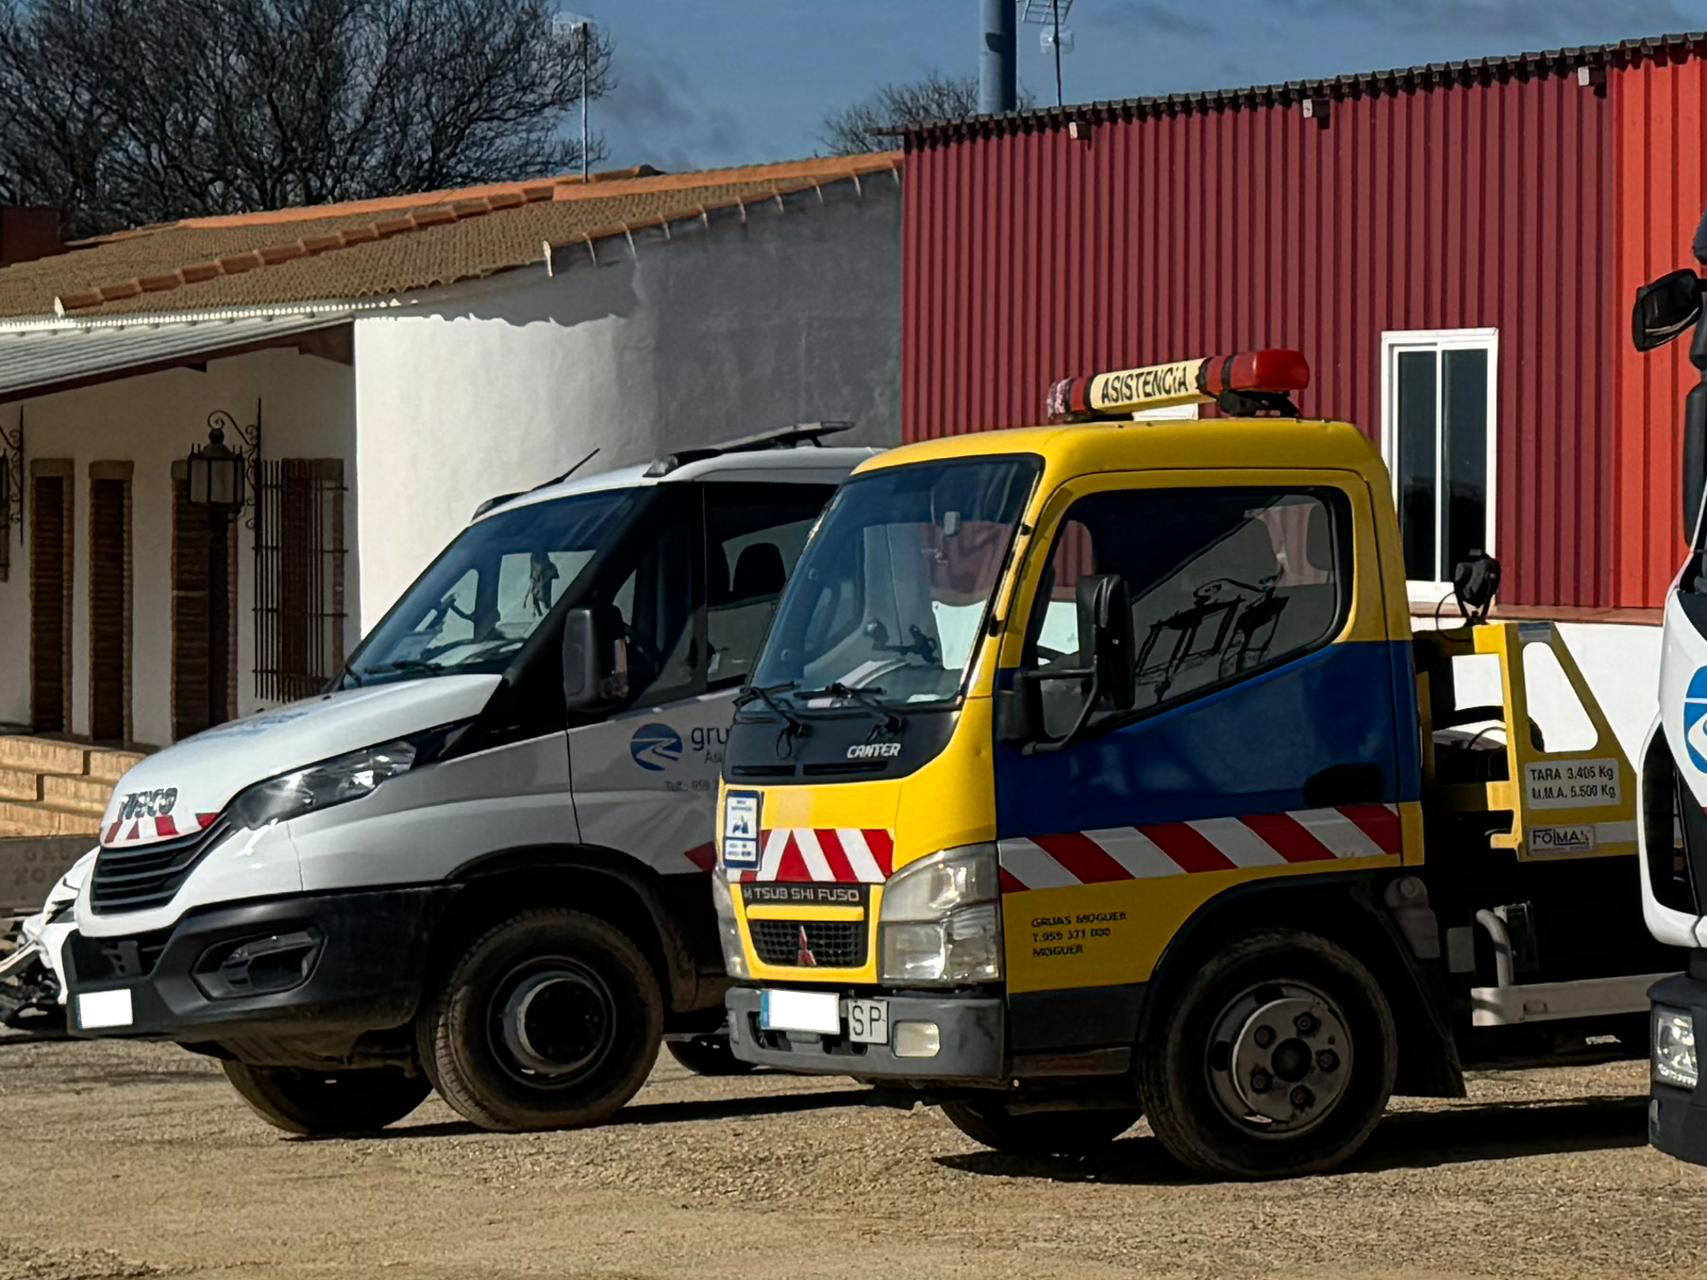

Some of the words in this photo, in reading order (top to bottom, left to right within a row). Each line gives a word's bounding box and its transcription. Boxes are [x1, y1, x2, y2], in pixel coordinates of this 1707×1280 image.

[1102, 365, 1189, 404] ASISTENCIA
[691, 727, 730, 752] gru
[847, 742, 901, 759] CANTER
[1530, 767, 1562, 781] TARA
[1599, 765, 1614, 781] Kg
[1601, 783, 1616, 799] Kg
[820, 888, 860, 902] FUSO
